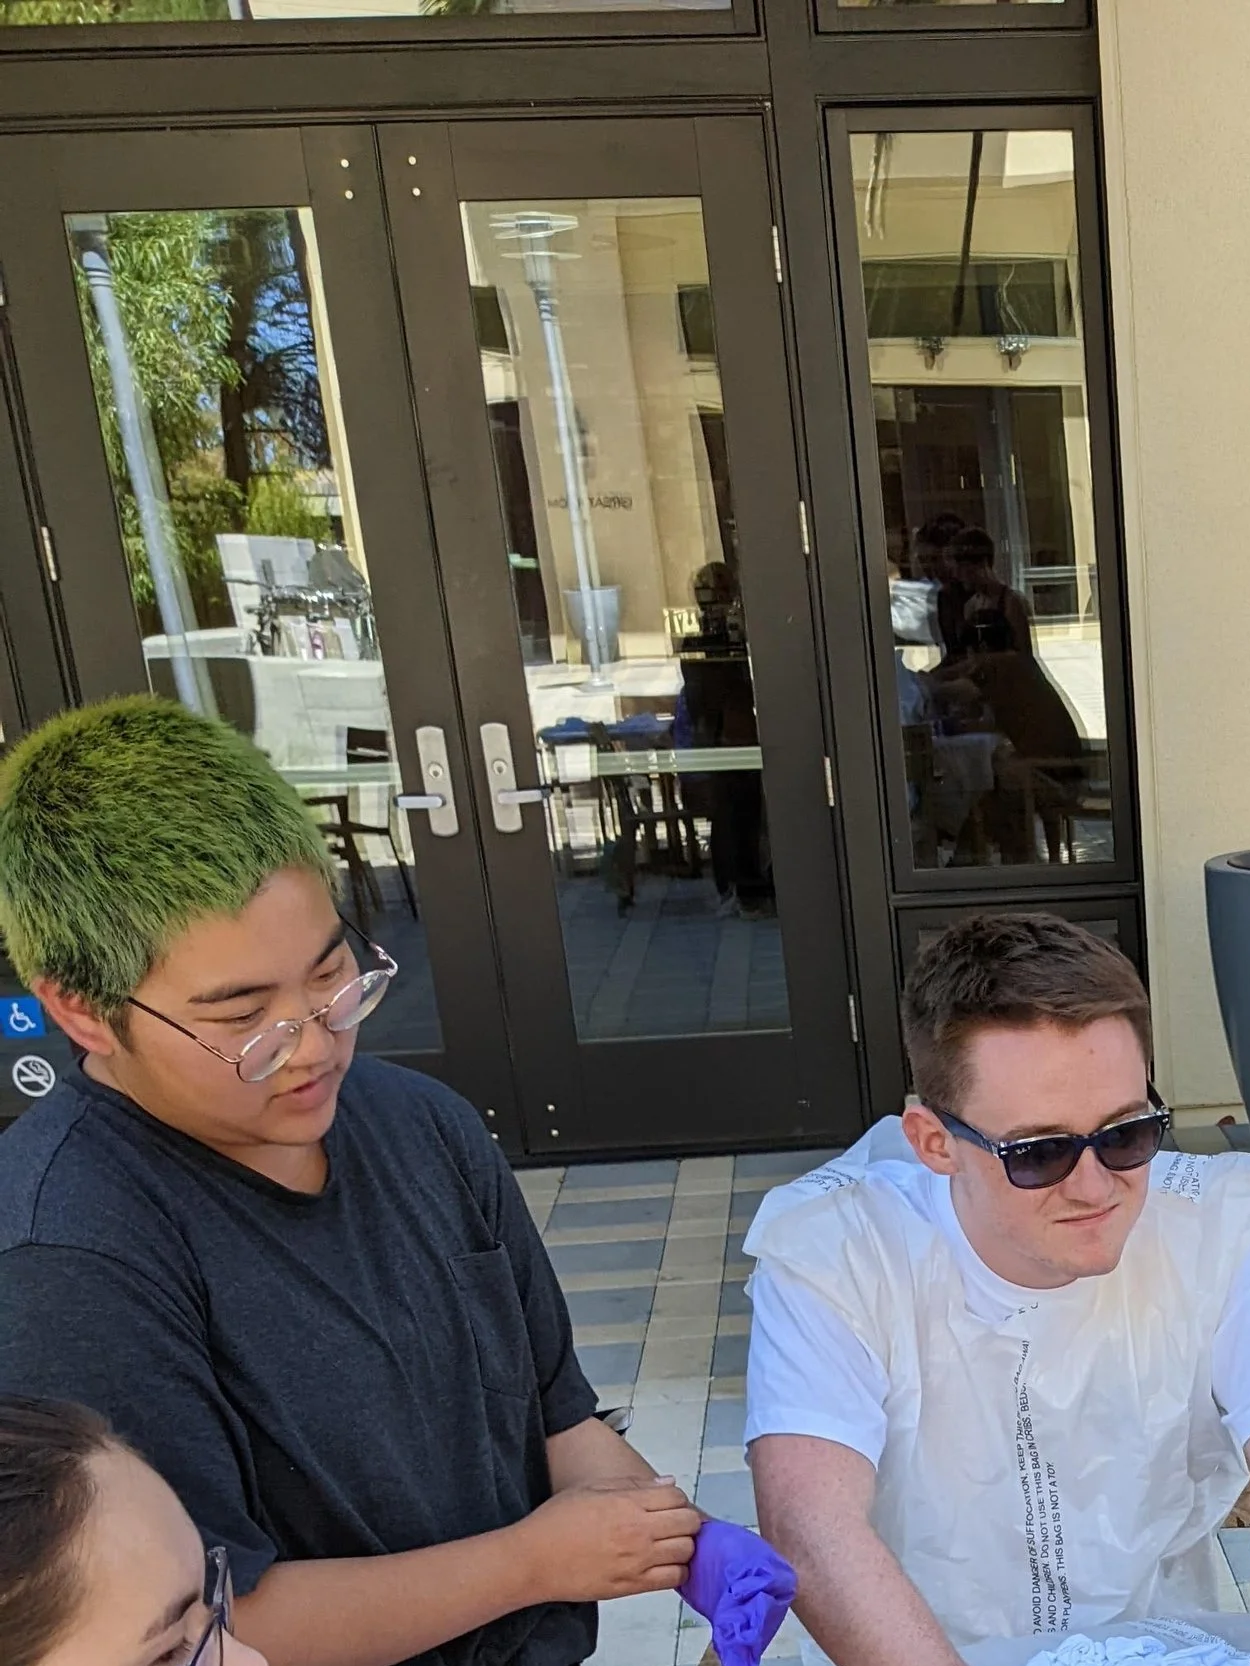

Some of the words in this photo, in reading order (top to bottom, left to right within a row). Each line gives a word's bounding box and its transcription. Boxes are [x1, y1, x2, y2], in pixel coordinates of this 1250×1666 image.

[1016, 1443, 1027, 1471] KEEP
[1030, 1450, 1041, 1470] BAG
[1034, 1472, 1043, 1496] THIS
[1049, 1480, 1058, 1488] A
[1037, 1499, 1047, 1520] USE
[1049, 1490, 1060, 1512] NOT
[1051, 1513, 1060, 1522] IS
[1040, 1522, 1049, 1543] NOT
[1053, 1525, 1064, 1546] BAG
[1040, 1544, 1049, 1558] DO
[1055, 1547, 1065, 1571] THIS
[1029, 1557, 1041, 1594] DANGER
[1032, 1595, 1042, 1627] AVOID
[1047, 1604, 1057, 1626] AND
